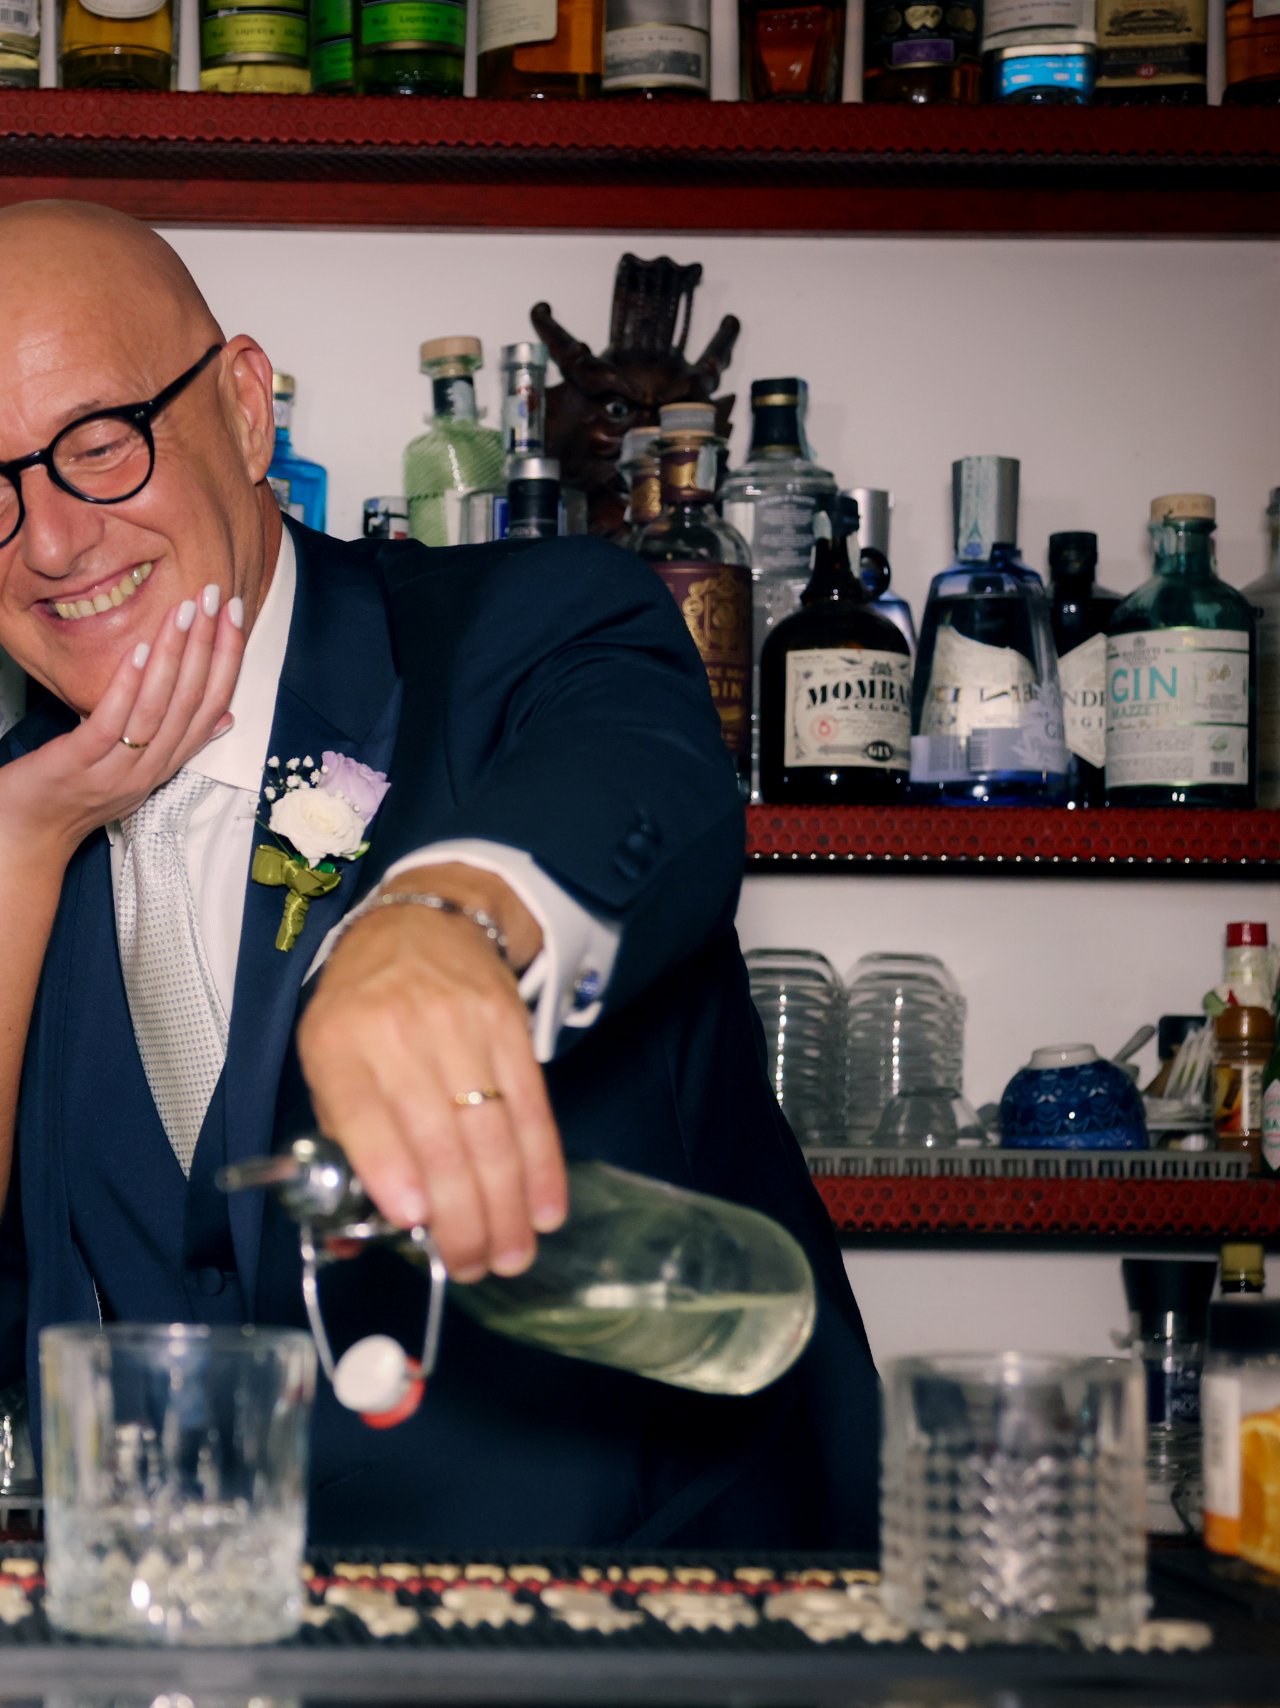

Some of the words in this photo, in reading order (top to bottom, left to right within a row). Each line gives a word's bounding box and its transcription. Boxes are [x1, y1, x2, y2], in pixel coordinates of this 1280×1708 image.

[709, 679, 742, 699] GIN
[806, 679, 911, 710] MOMBA
[1111, 666, 1177, 704] GIN
[866, 746, 892, 758] GIN
